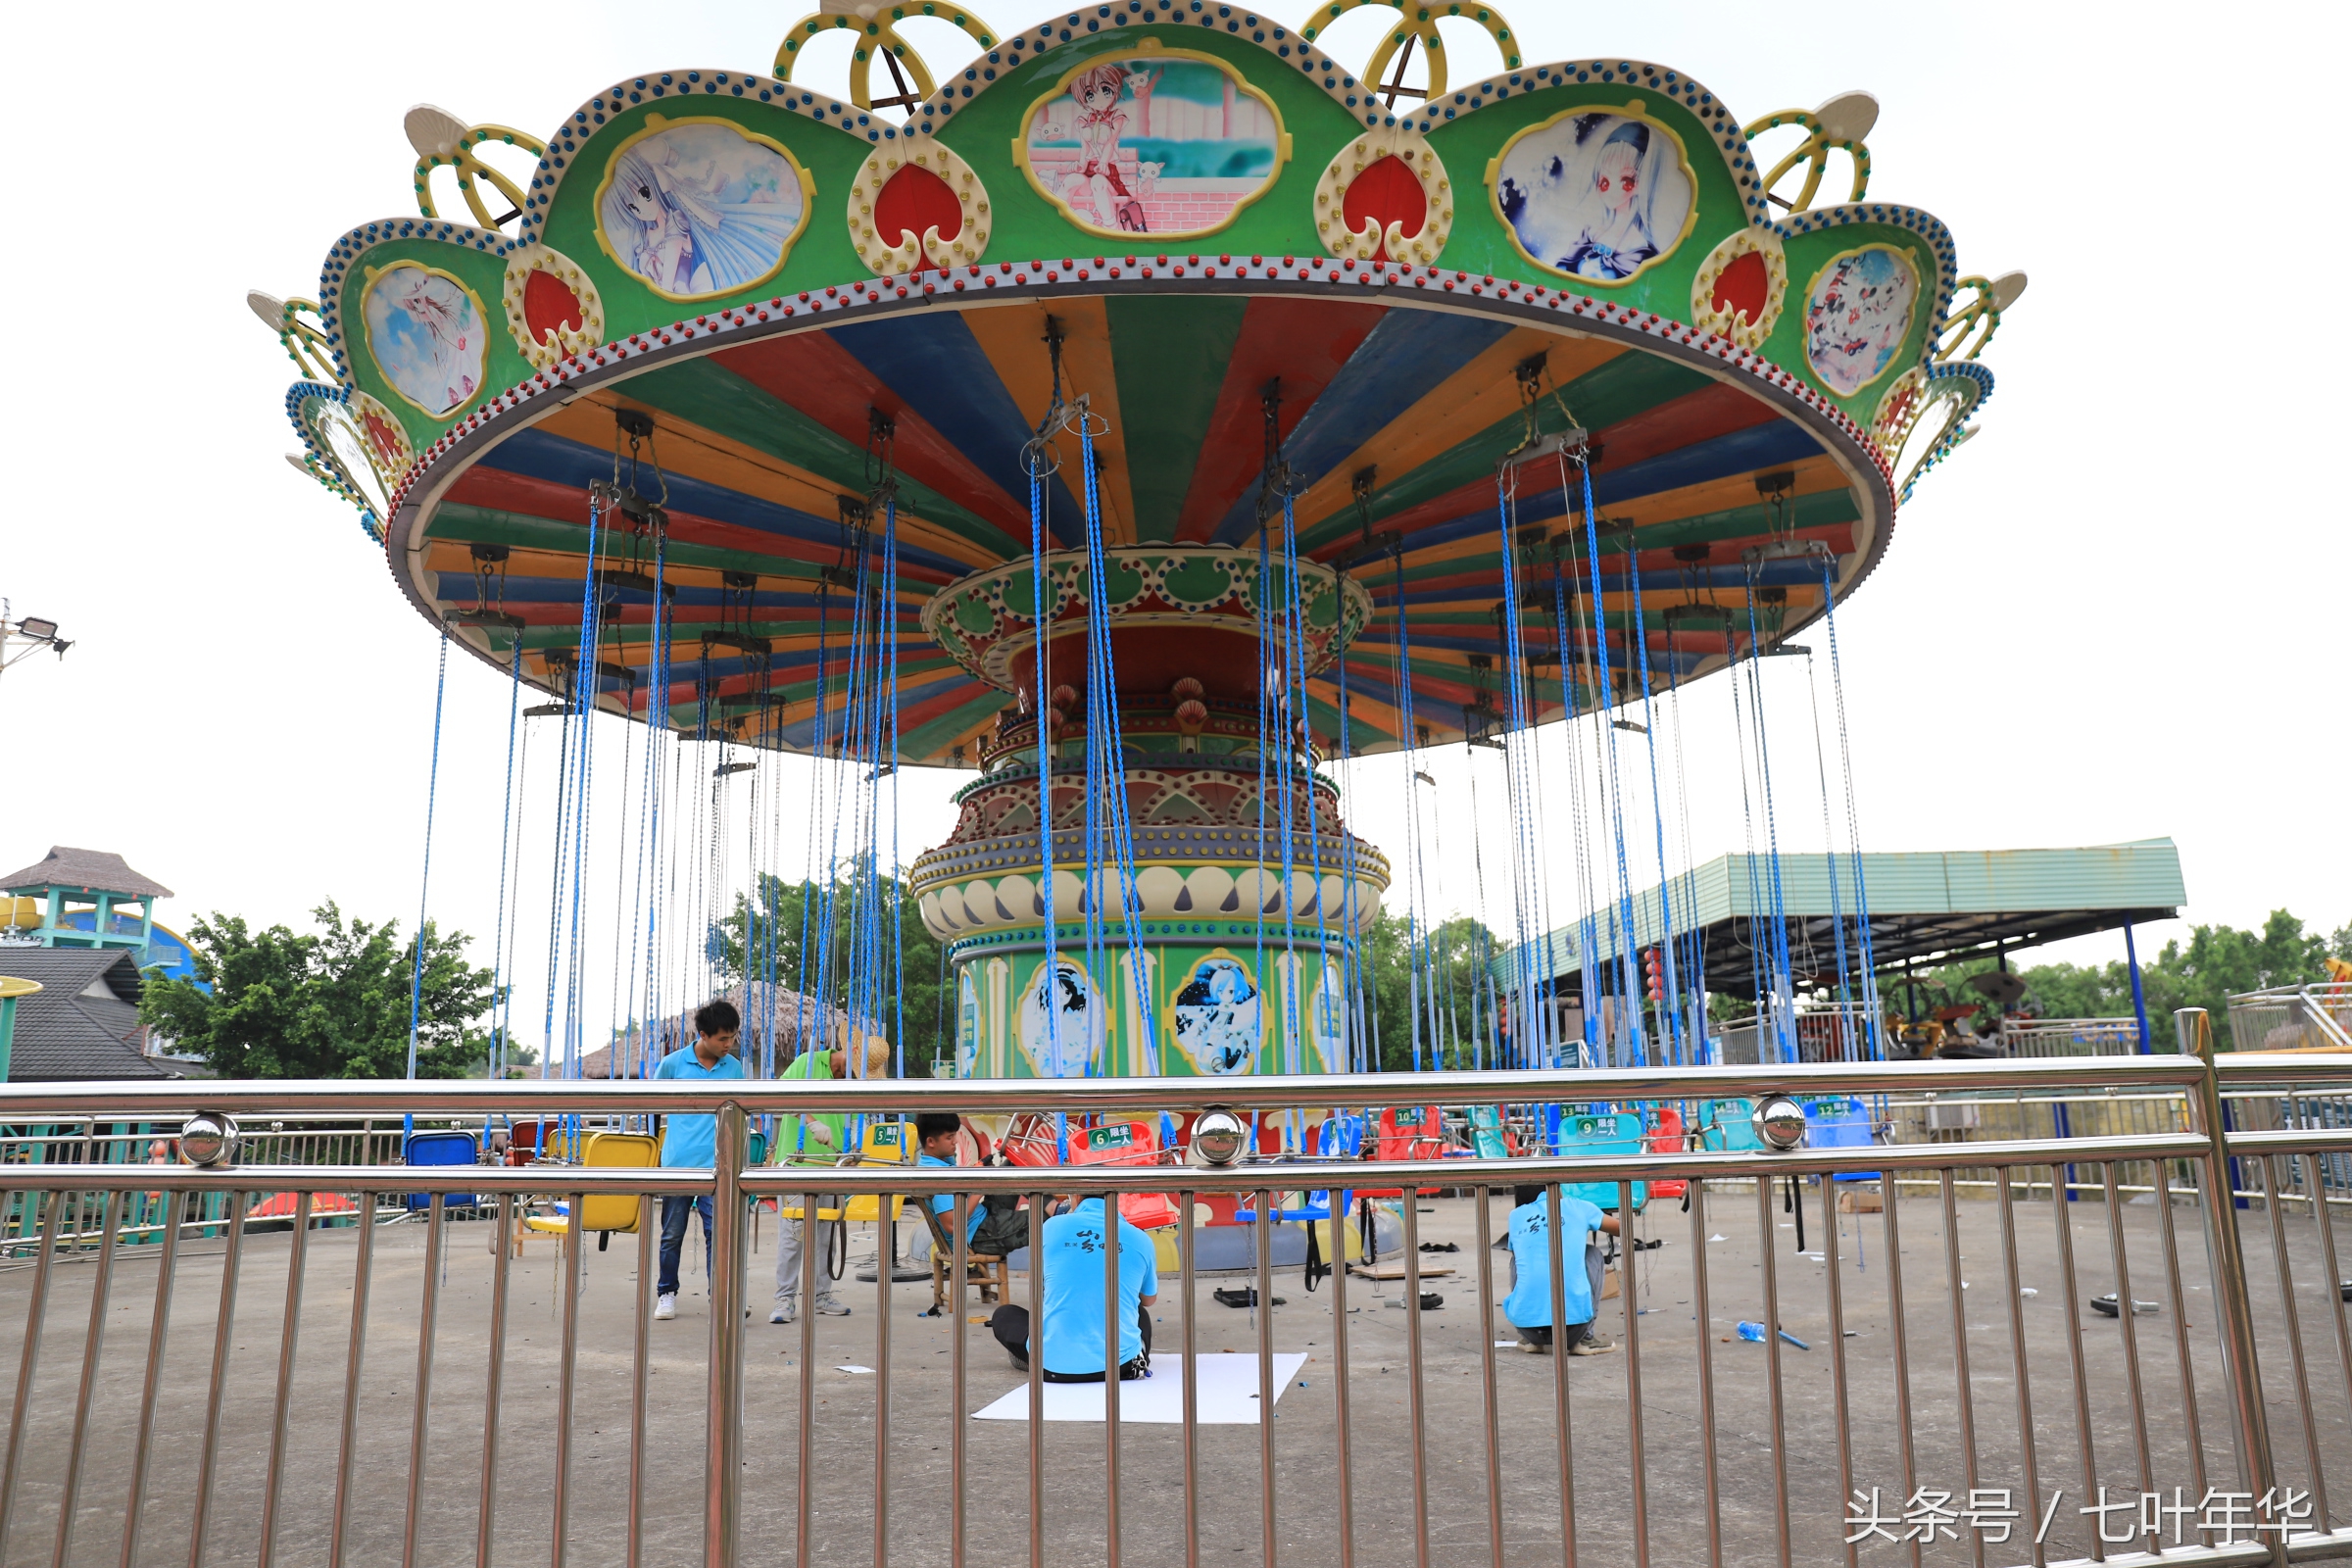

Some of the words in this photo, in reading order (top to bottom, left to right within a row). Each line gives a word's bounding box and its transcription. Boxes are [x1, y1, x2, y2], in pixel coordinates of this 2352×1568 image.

[1562, 1107, 1574, 1116] 13
[1819, 1105, 1833, 1115] 12
[1397, 1111, 1410, 1122] 10
[1584, 1123, 1592, 1134] 9
[1597, 1118, 1617, 1128] 限坐
[877, 1130, 884, 1141] 5
[1109, 1125, 1130, 1138] 限坐
[1597, 1126, 1617, 1136] 一人
[886, 1135, 897, 1144] 一人
[1096, 1133, 1104, 1145] 6
[1110, 1135, 1131, 1146] 一人
